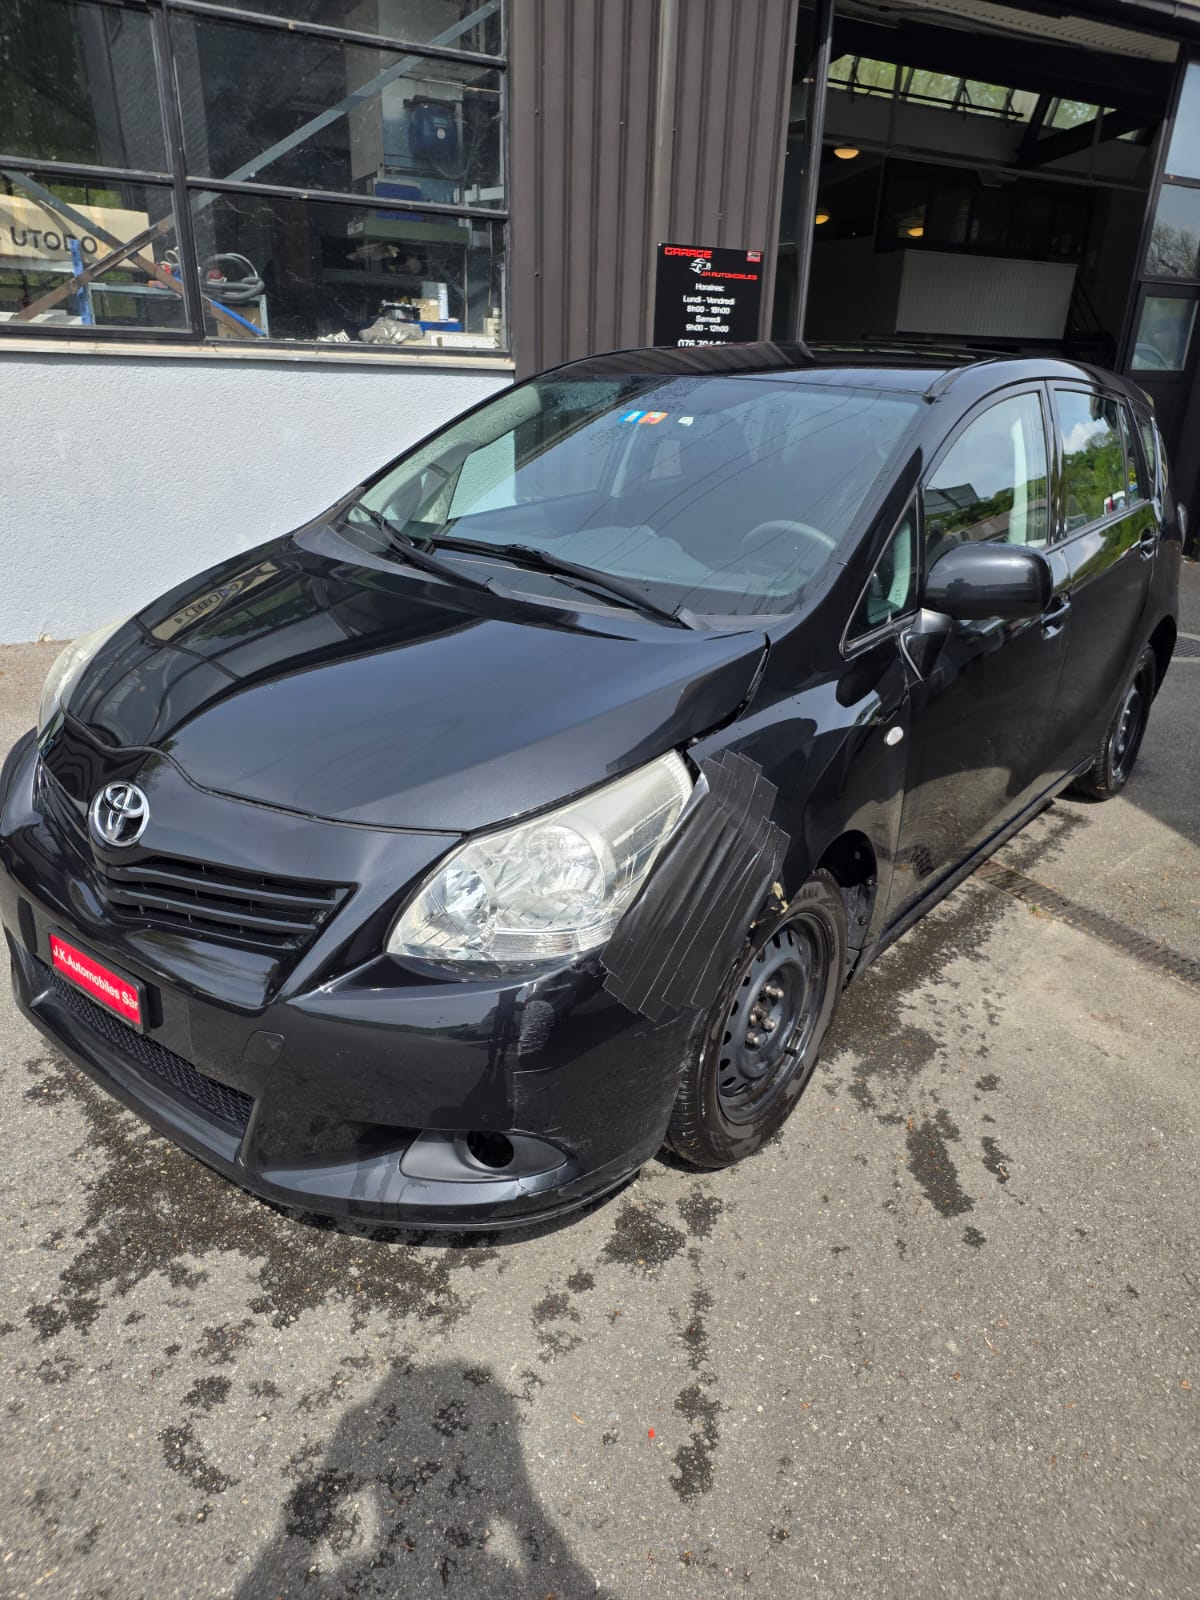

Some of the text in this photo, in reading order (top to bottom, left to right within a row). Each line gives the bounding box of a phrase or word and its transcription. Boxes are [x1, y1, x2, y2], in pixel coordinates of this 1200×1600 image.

[664, 247, 712, 258] GARAGE
[711, 271, 758, 280] AUTOMOBILES
[683, 295, 702, 303] Lundi
[706, 296, 735, 305] Vendredi
[695, 315, 721, 323] Samedi
